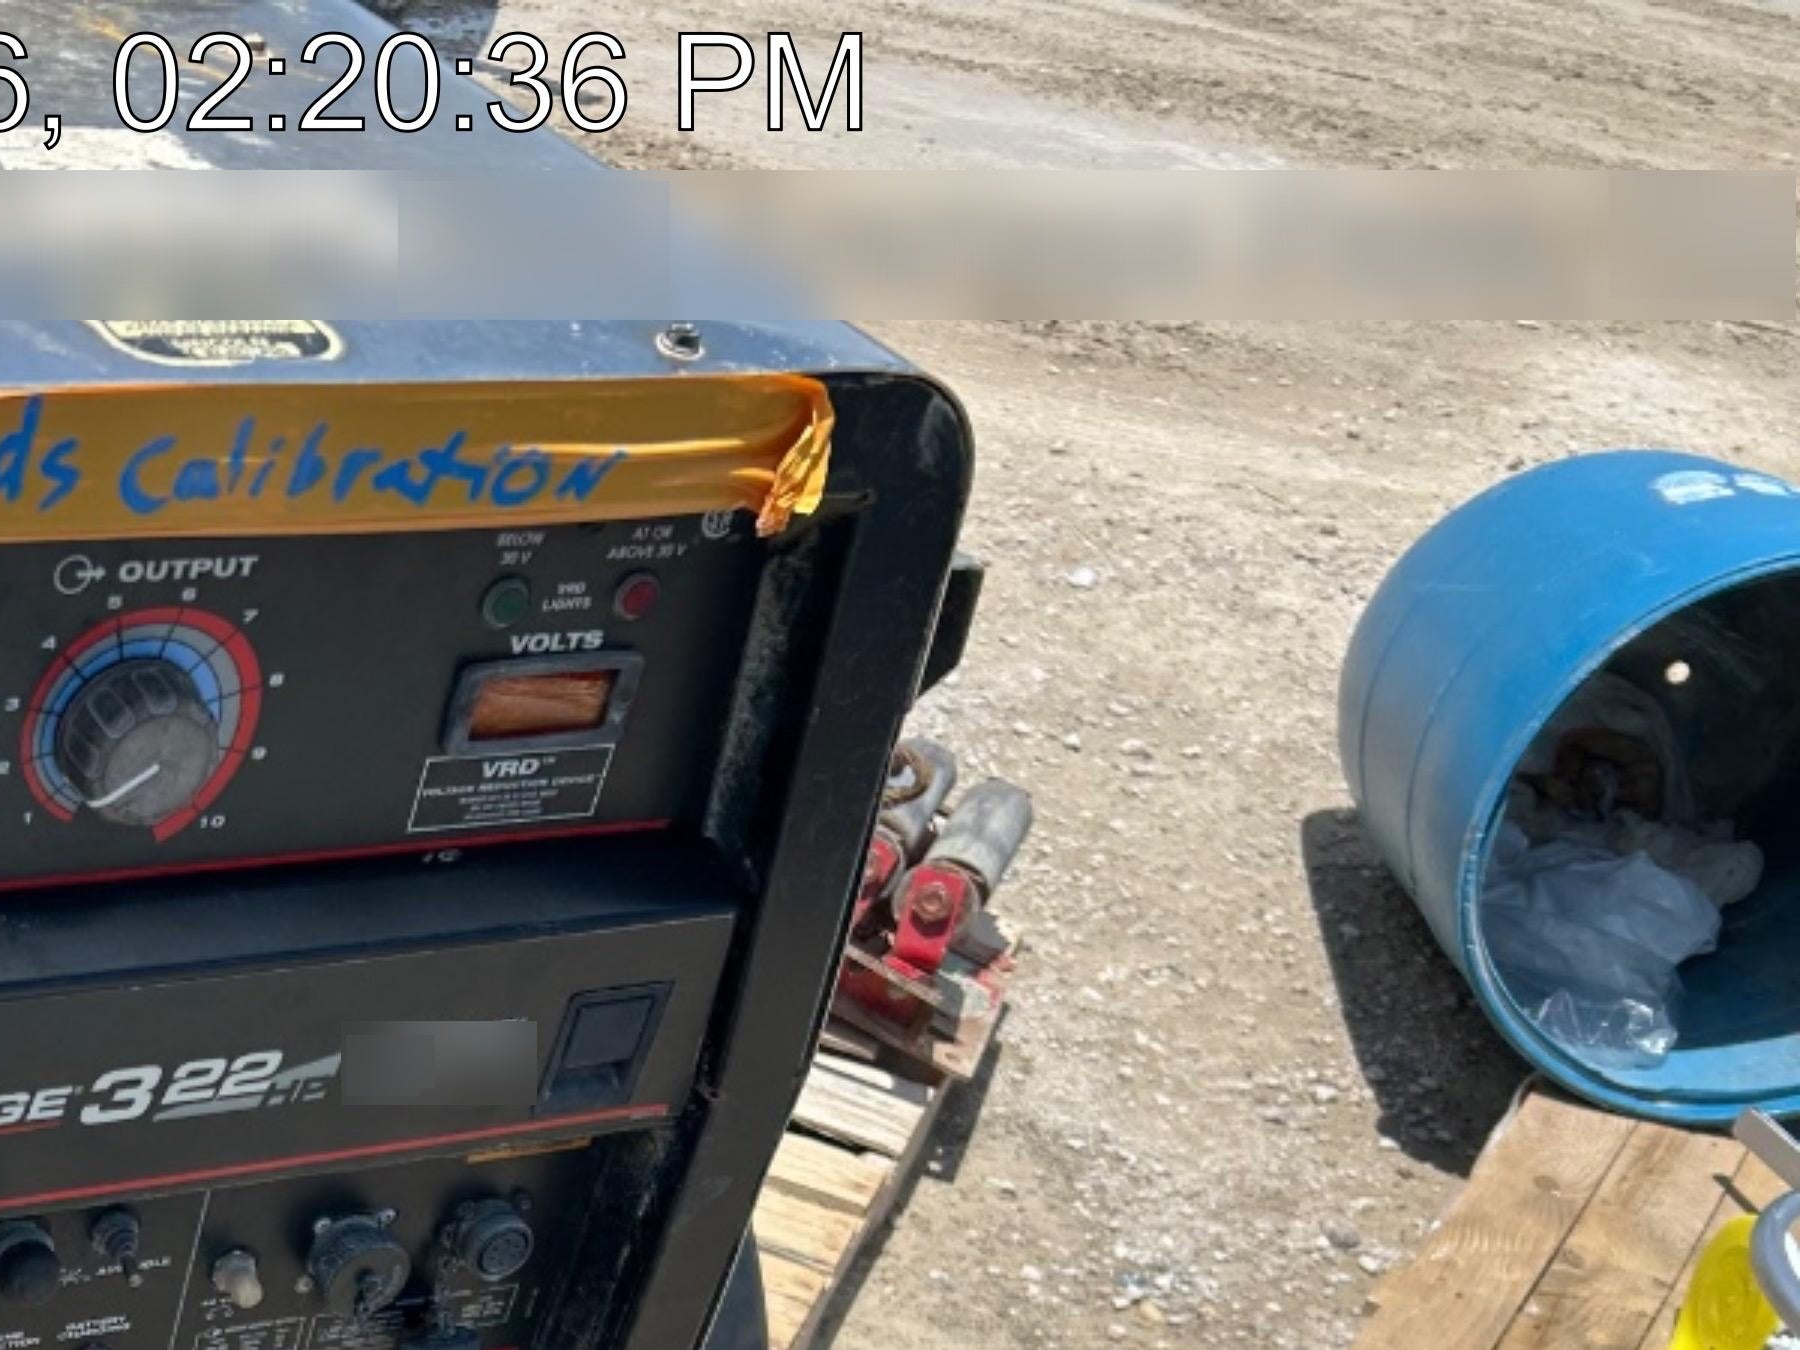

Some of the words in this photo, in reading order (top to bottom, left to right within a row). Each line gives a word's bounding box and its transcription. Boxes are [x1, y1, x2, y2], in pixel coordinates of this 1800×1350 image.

[119, 418, 628, 515] Calibration
[118, 555, 260, 583] OUTPUT
[243, 608, 259, 623] 7
[41, 635, 57, 650] 4
[510, 629, 605, 654] VOLTS
[200, 815, 226, 829] 10
[80, 1050, 284, 1126] 322
